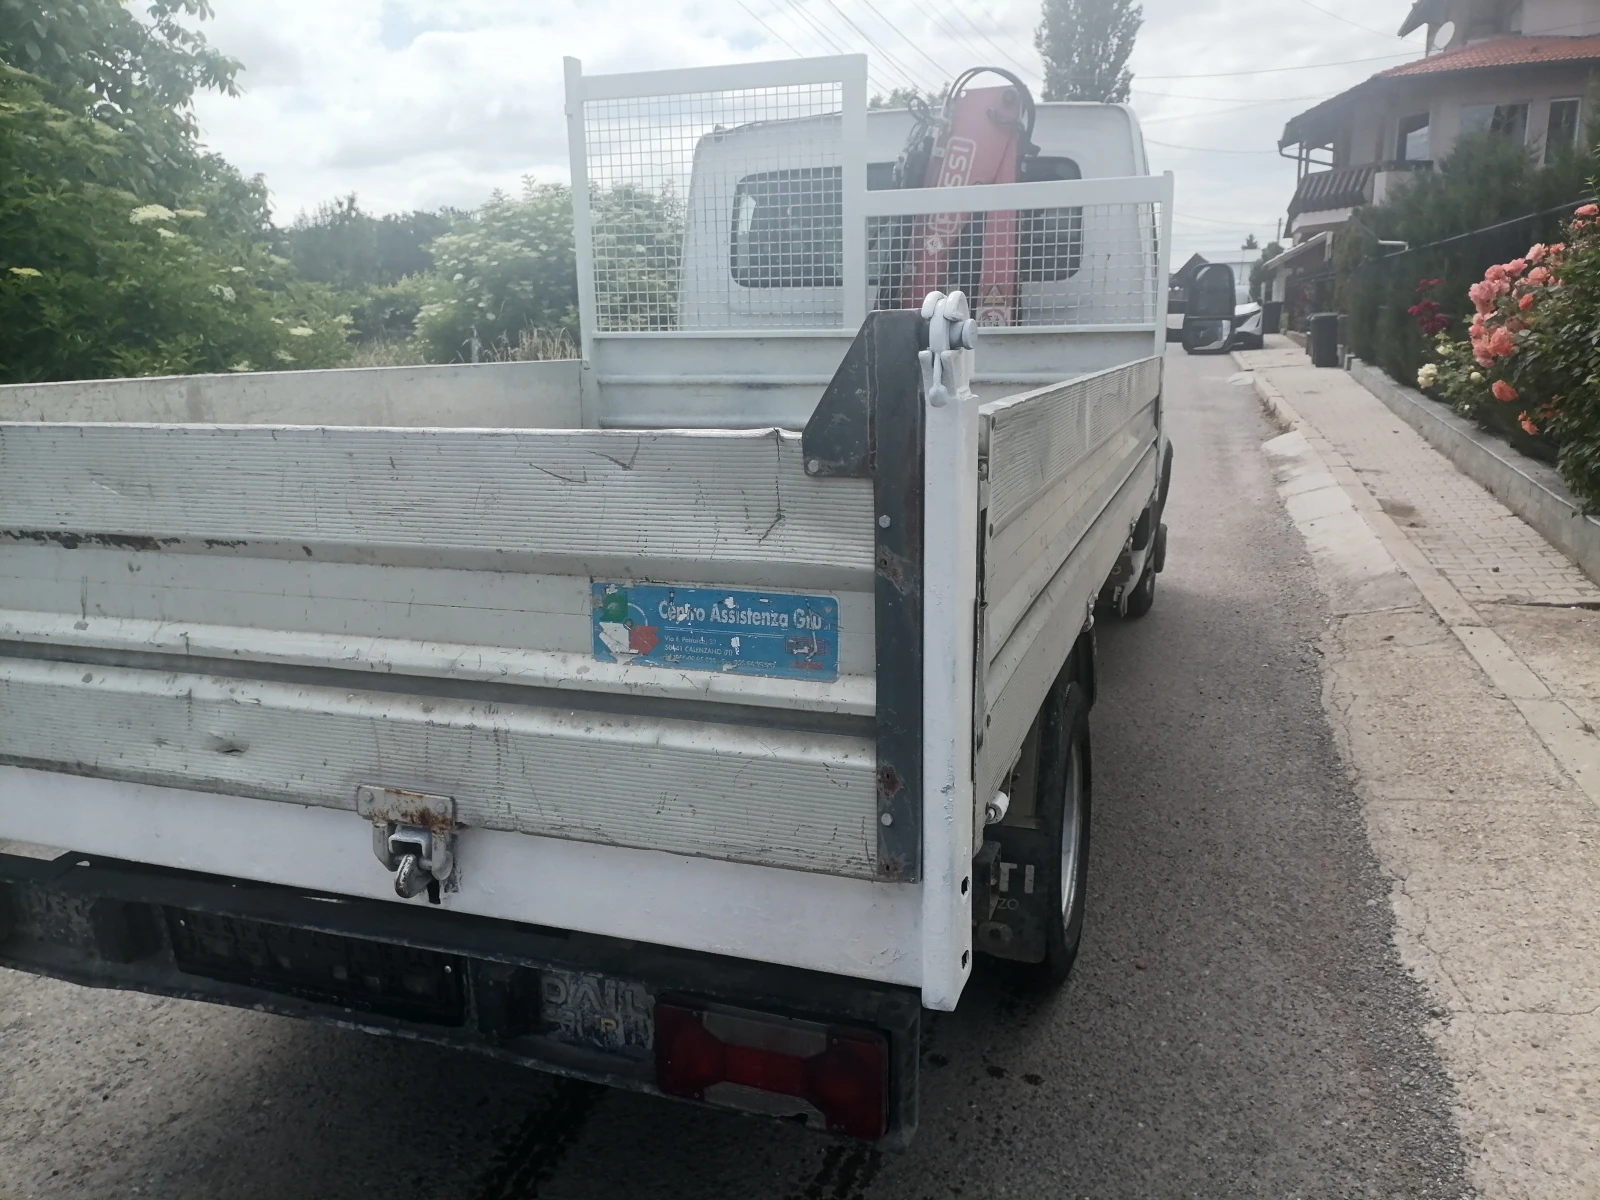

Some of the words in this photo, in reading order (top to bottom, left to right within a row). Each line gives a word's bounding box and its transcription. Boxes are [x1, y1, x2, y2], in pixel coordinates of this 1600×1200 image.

[936, 145, 970, 224] FSSI
[709, 603, 788, 628] Assistenza
[793, 608, 822, 630] Gru
[684, 645, 722, 655] CALENZANO
[999, 862, 1035, 894] TI
[997, 898, 1019, 910] ZO
